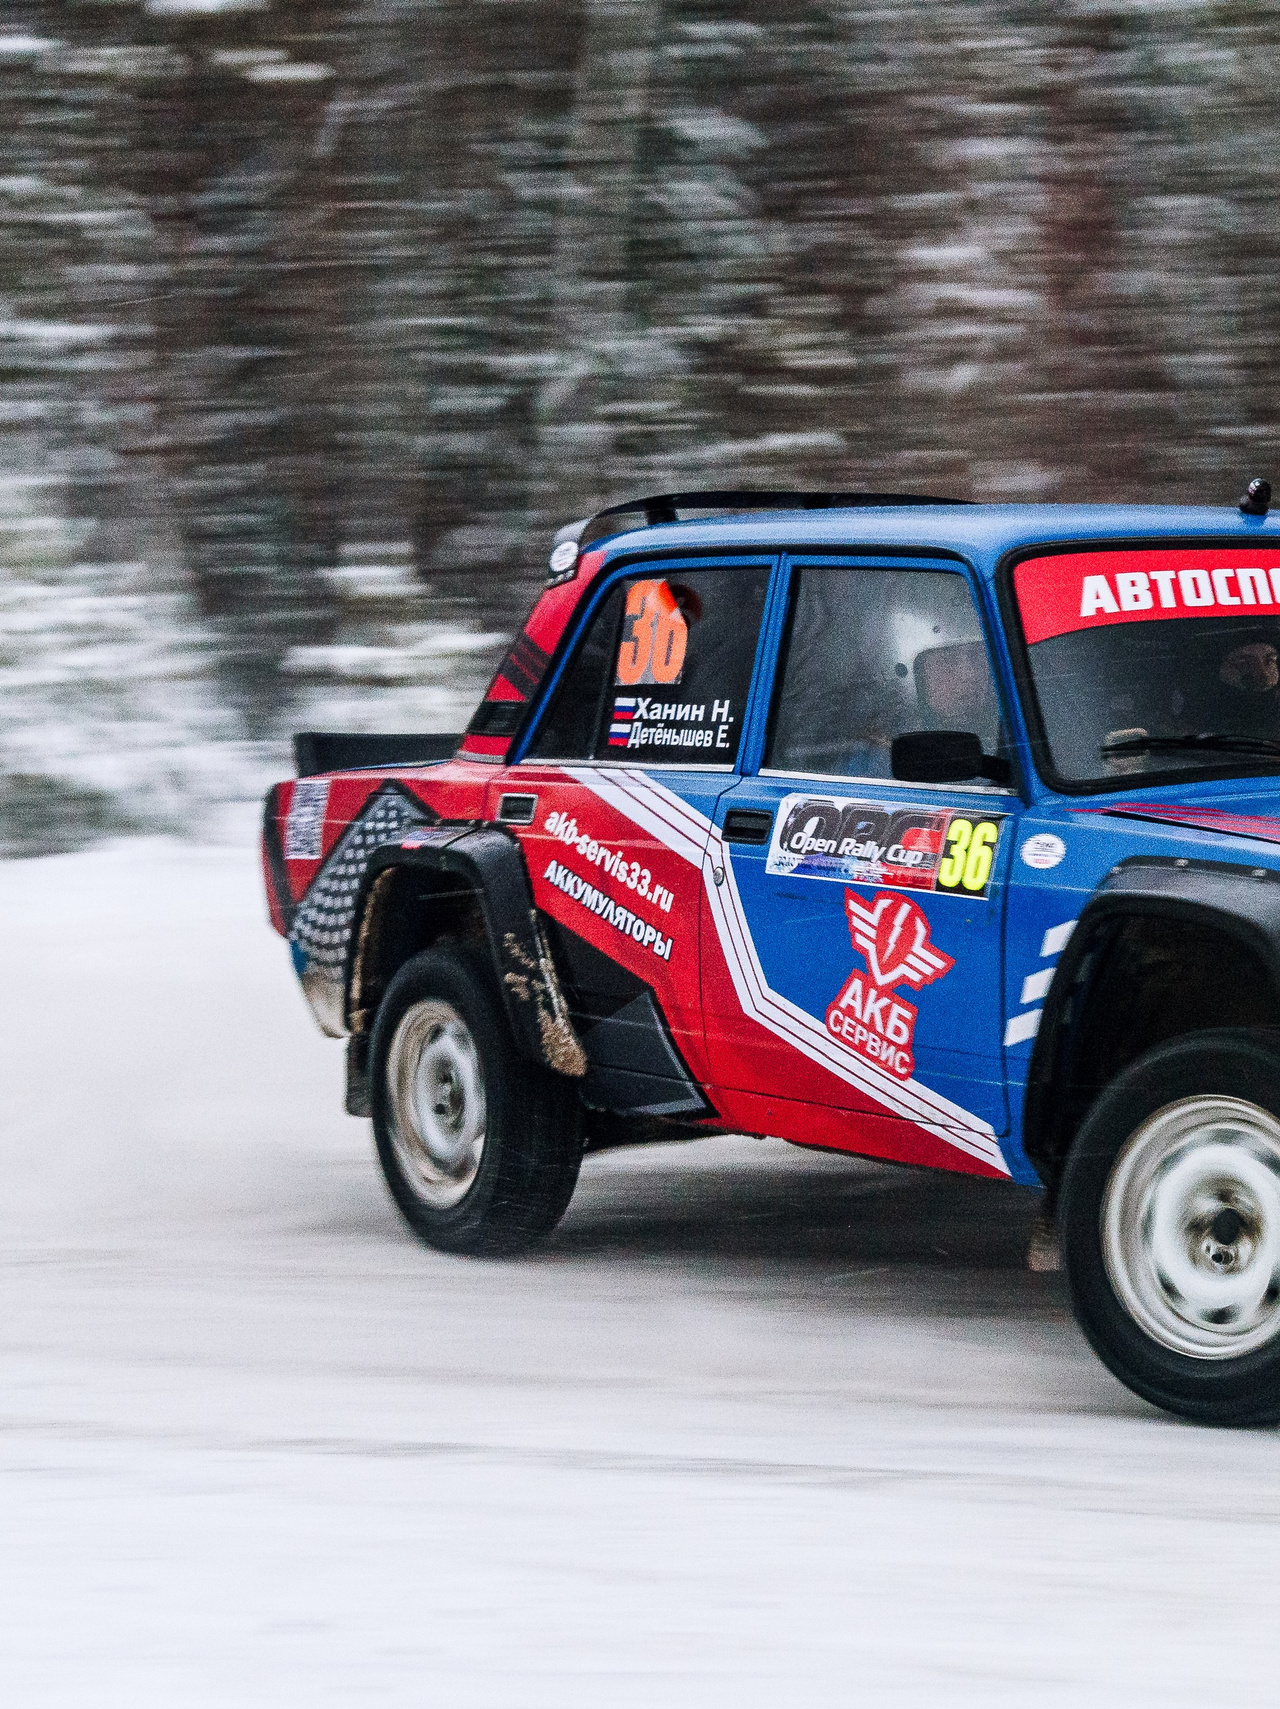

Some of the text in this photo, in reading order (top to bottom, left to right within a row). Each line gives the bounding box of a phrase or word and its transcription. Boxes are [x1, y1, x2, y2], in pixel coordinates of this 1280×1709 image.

[627, 721, 730, 748] Детёнышев Е.
[633, 697, 734, 722] Ханин Н.
[544, 811, 675, 913] akb-servis33.ru
[790, 831, 924, 865] Open Rally Cup
[938, 818, 998, 890] 36
[542, 859, 674, 961] АККУМУЛЯТОРЫ
[829, 1009, 910, 1075] СЕРВИС
[839, 977, 913, 1045] АКБ
